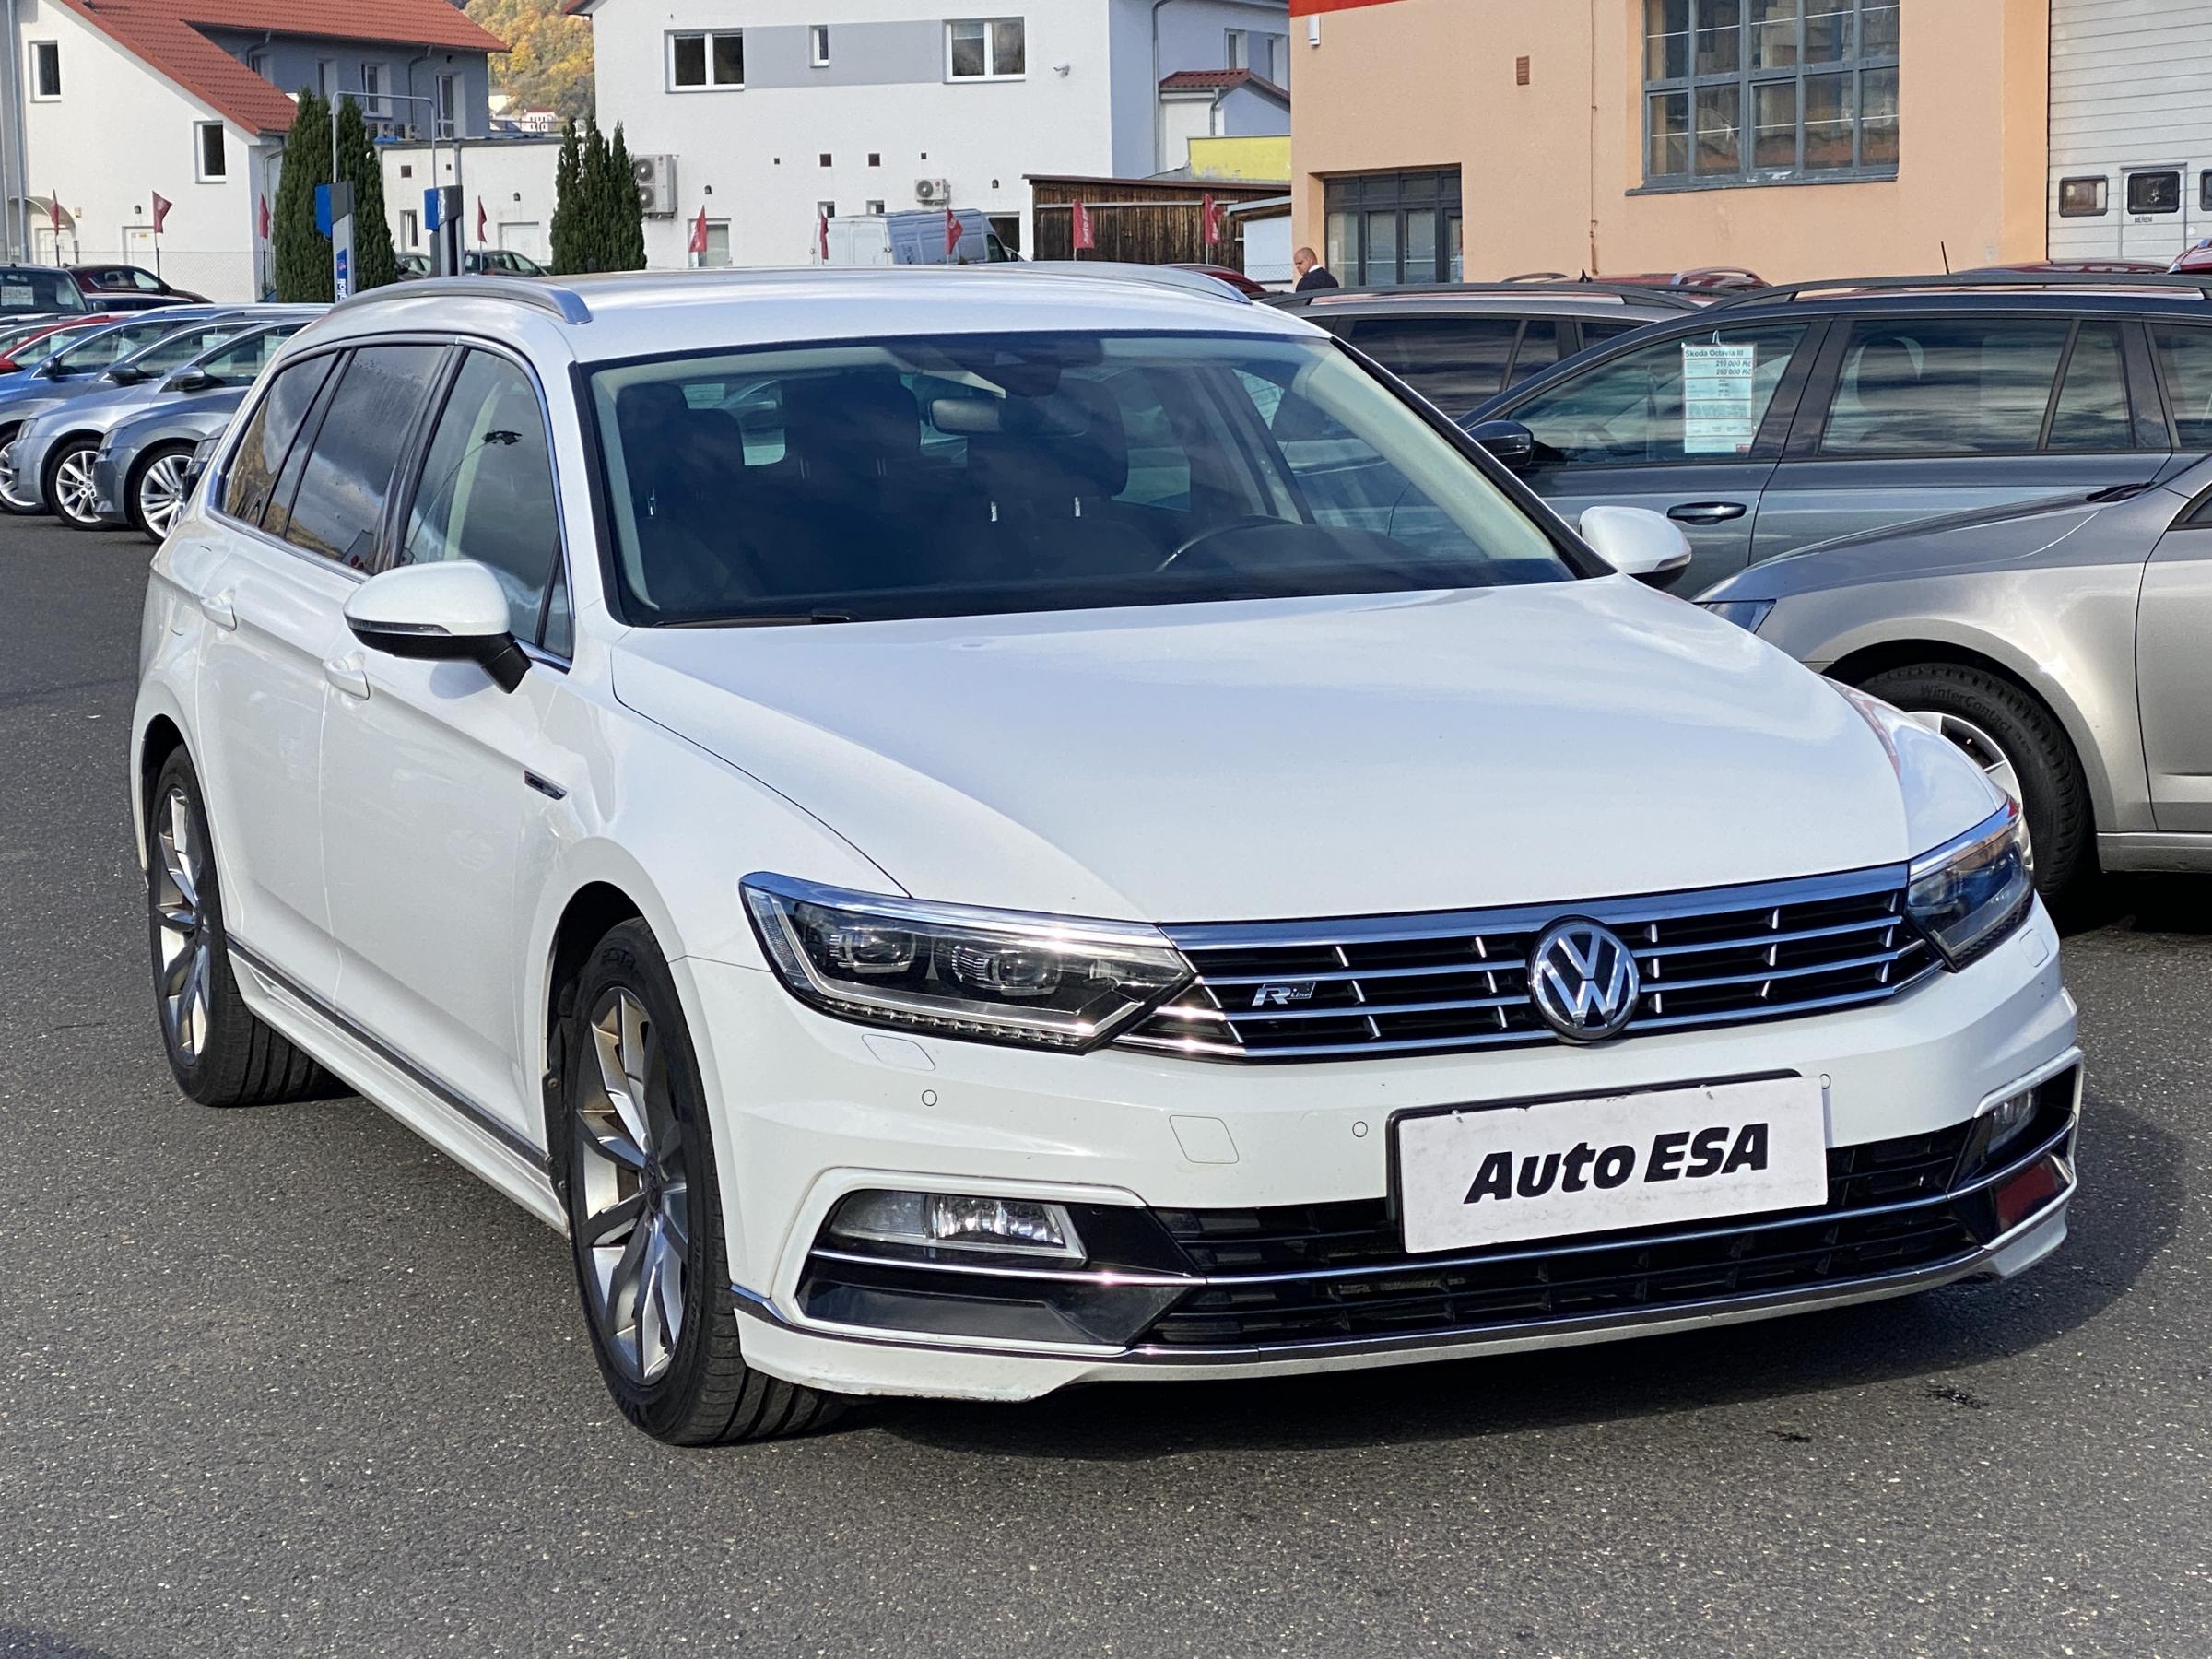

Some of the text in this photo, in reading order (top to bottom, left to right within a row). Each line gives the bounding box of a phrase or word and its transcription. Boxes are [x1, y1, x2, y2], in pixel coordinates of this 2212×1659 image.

[1920, 685, 2013, 733] WinterContact
[1252, 987, 1291, 1006] R
[1464, 1123, 1769, 1205] Auto ESA
